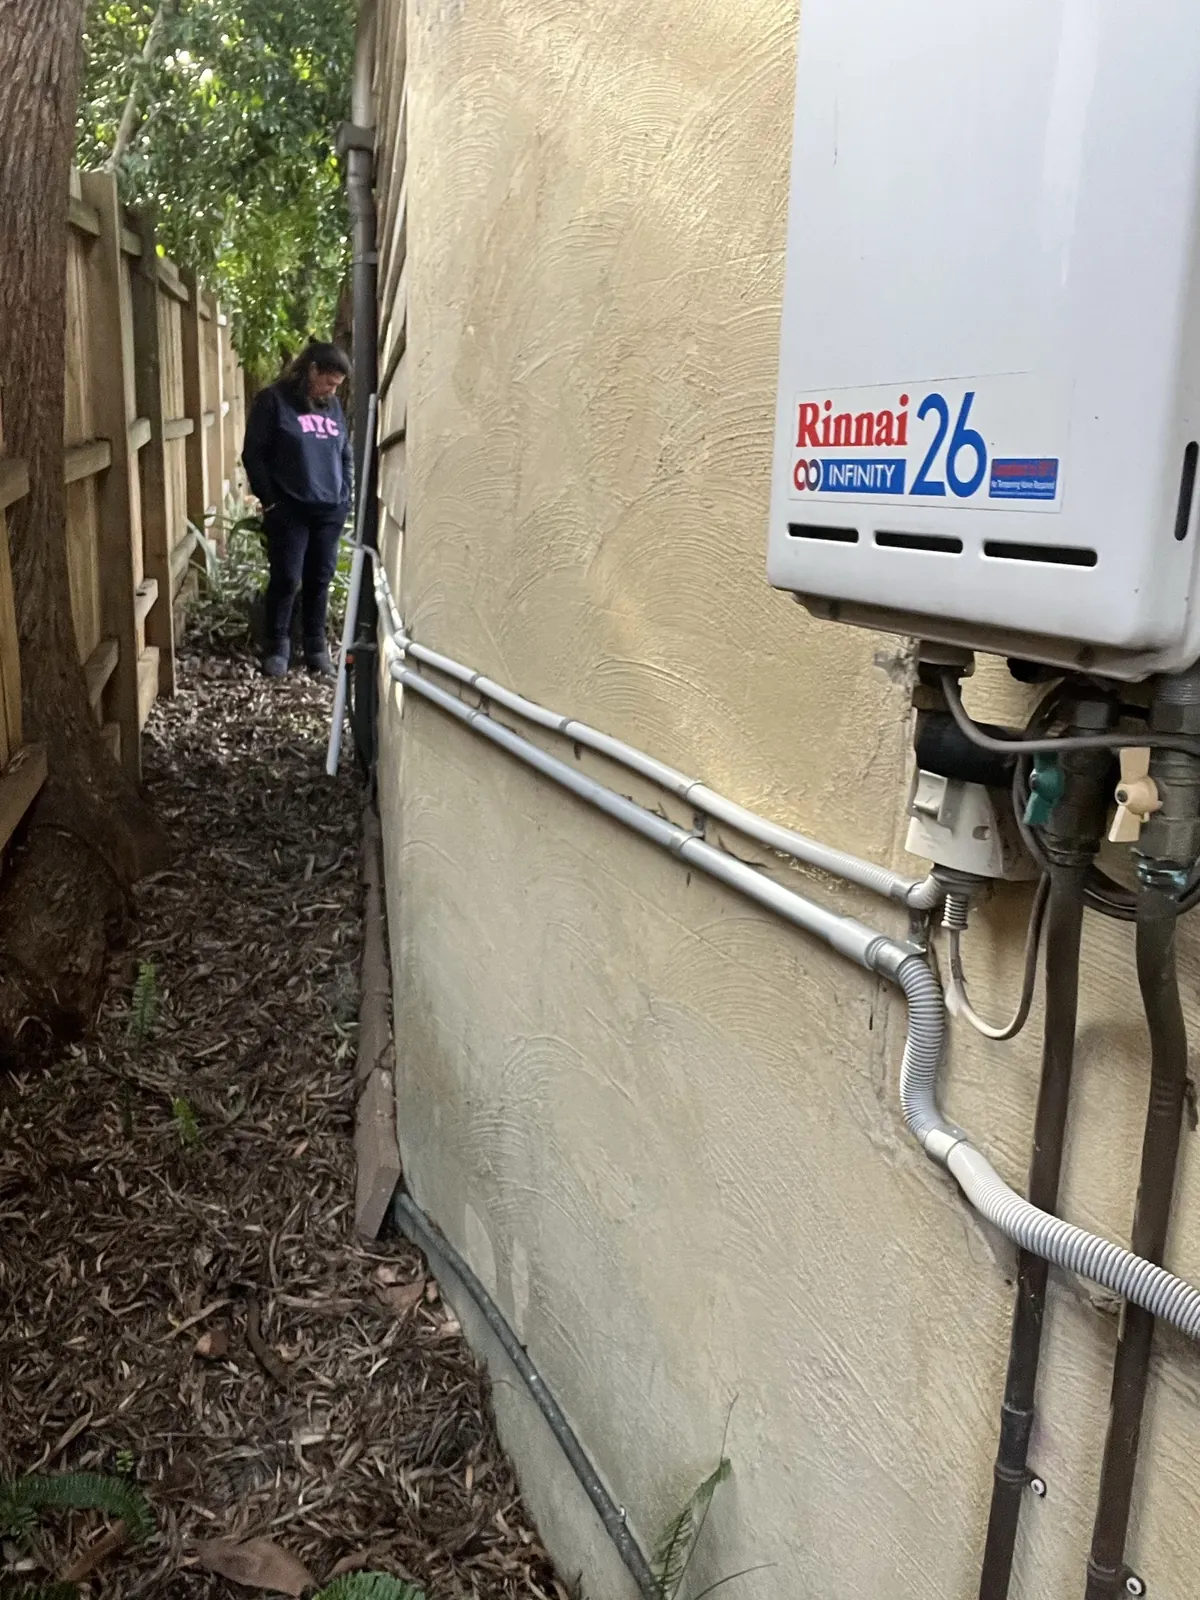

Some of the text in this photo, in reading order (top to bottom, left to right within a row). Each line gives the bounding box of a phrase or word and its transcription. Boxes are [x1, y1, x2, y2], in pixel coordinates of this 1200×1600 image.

[297, 414, 339, 436] NYC
[796, 392, 987, 498] Rinnai 26
[829, 464, 896, 488] INFINITY
